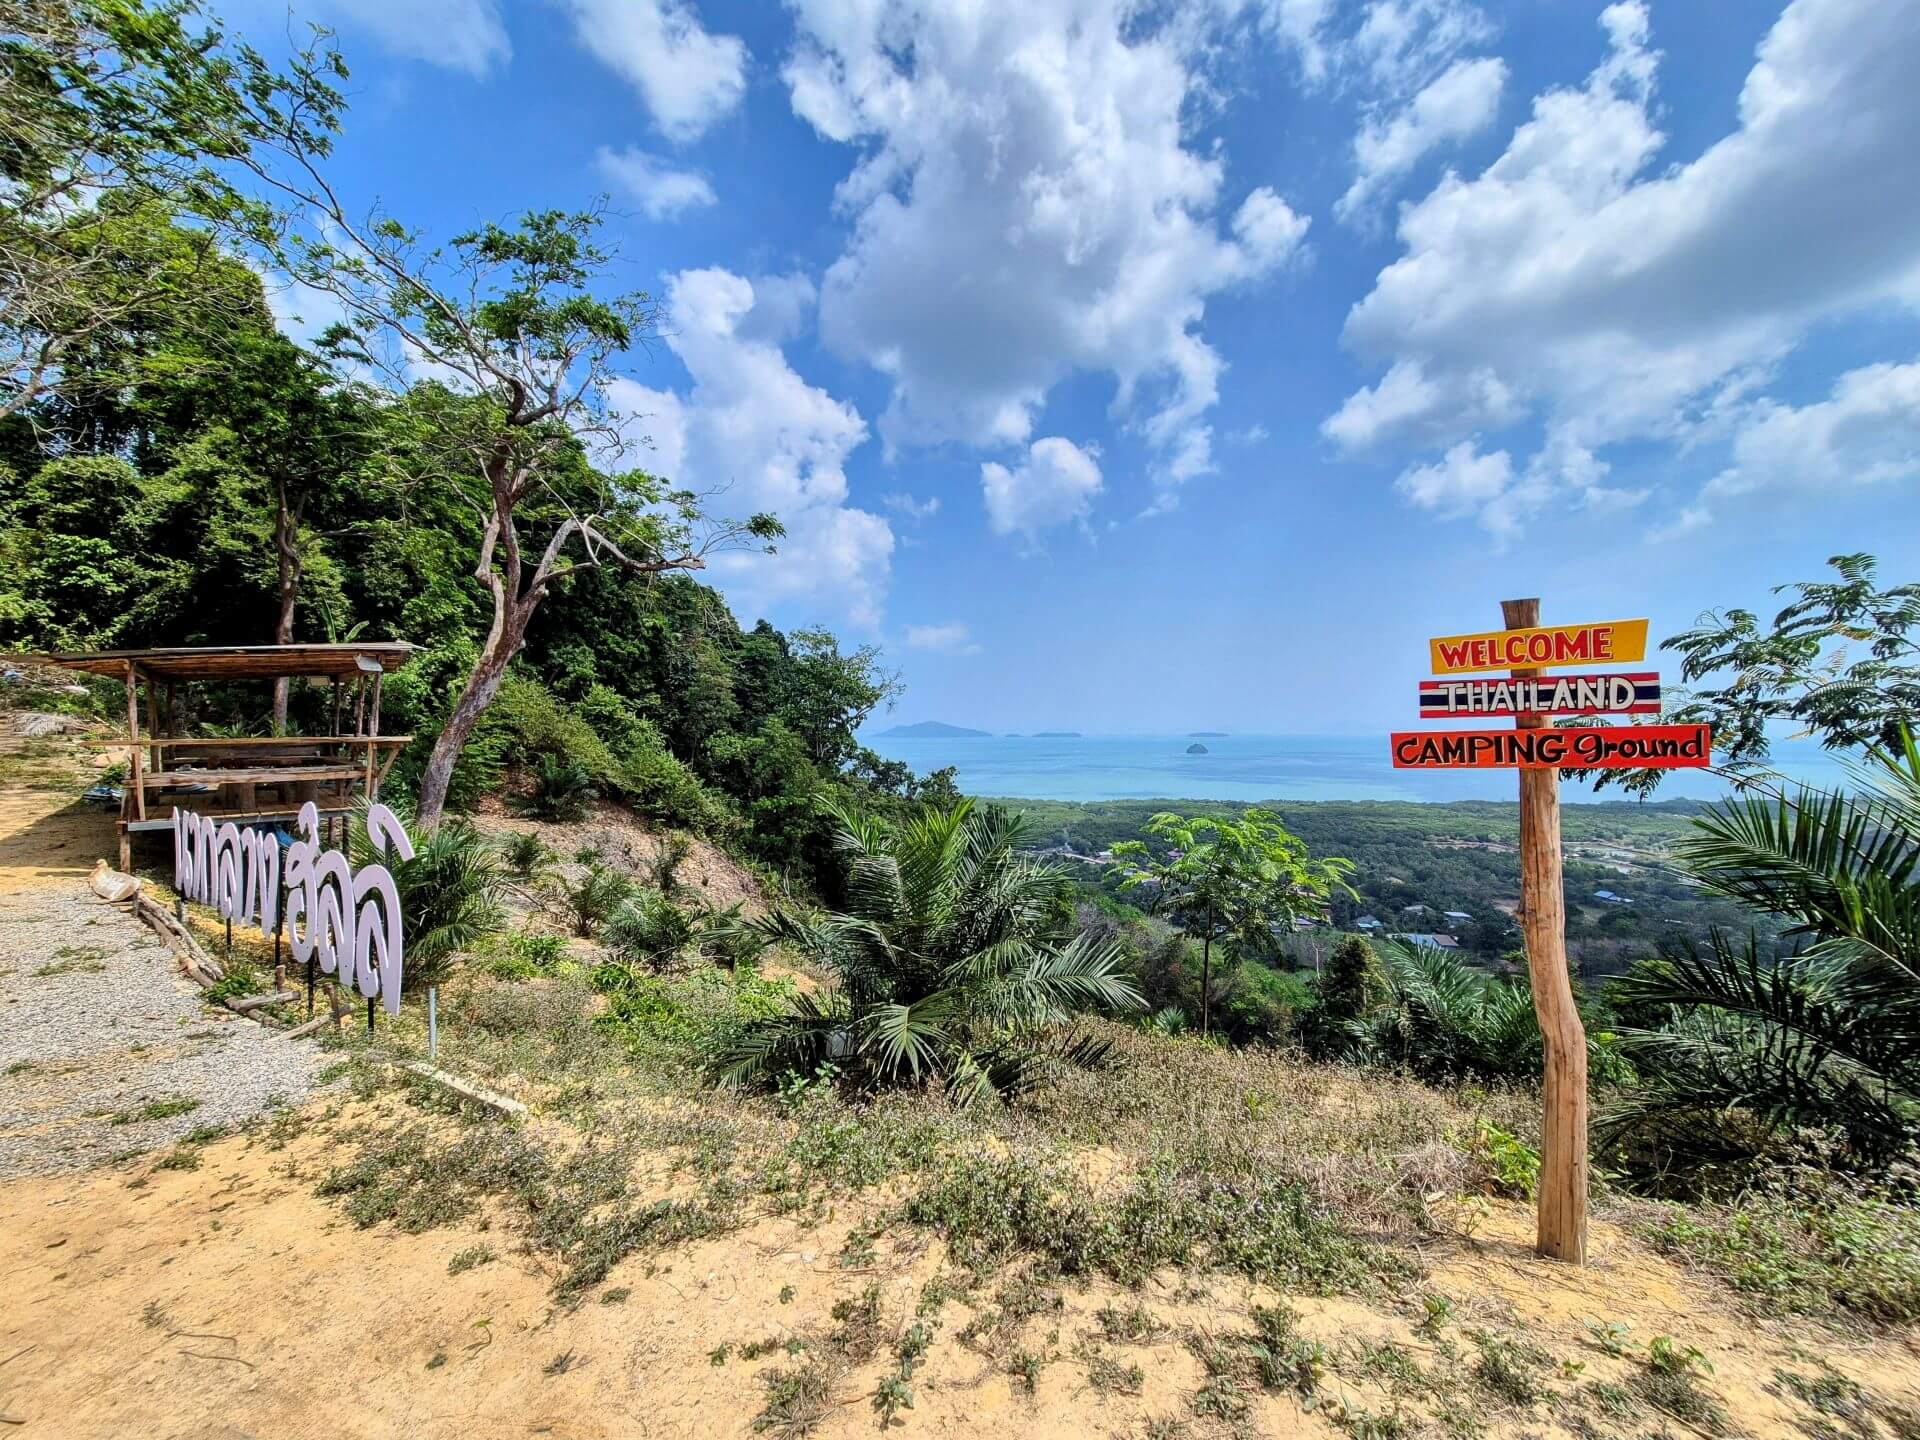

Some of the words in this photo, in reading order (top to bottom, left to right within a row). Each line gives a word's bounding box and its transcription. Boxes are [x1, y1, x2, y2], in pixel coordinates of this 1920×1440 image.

[1437, 627, 1614, 668] WELCOME
[1438, 677, 1637, 714] THAILAND
[1396, 733, 1569, 766] CAMPING
